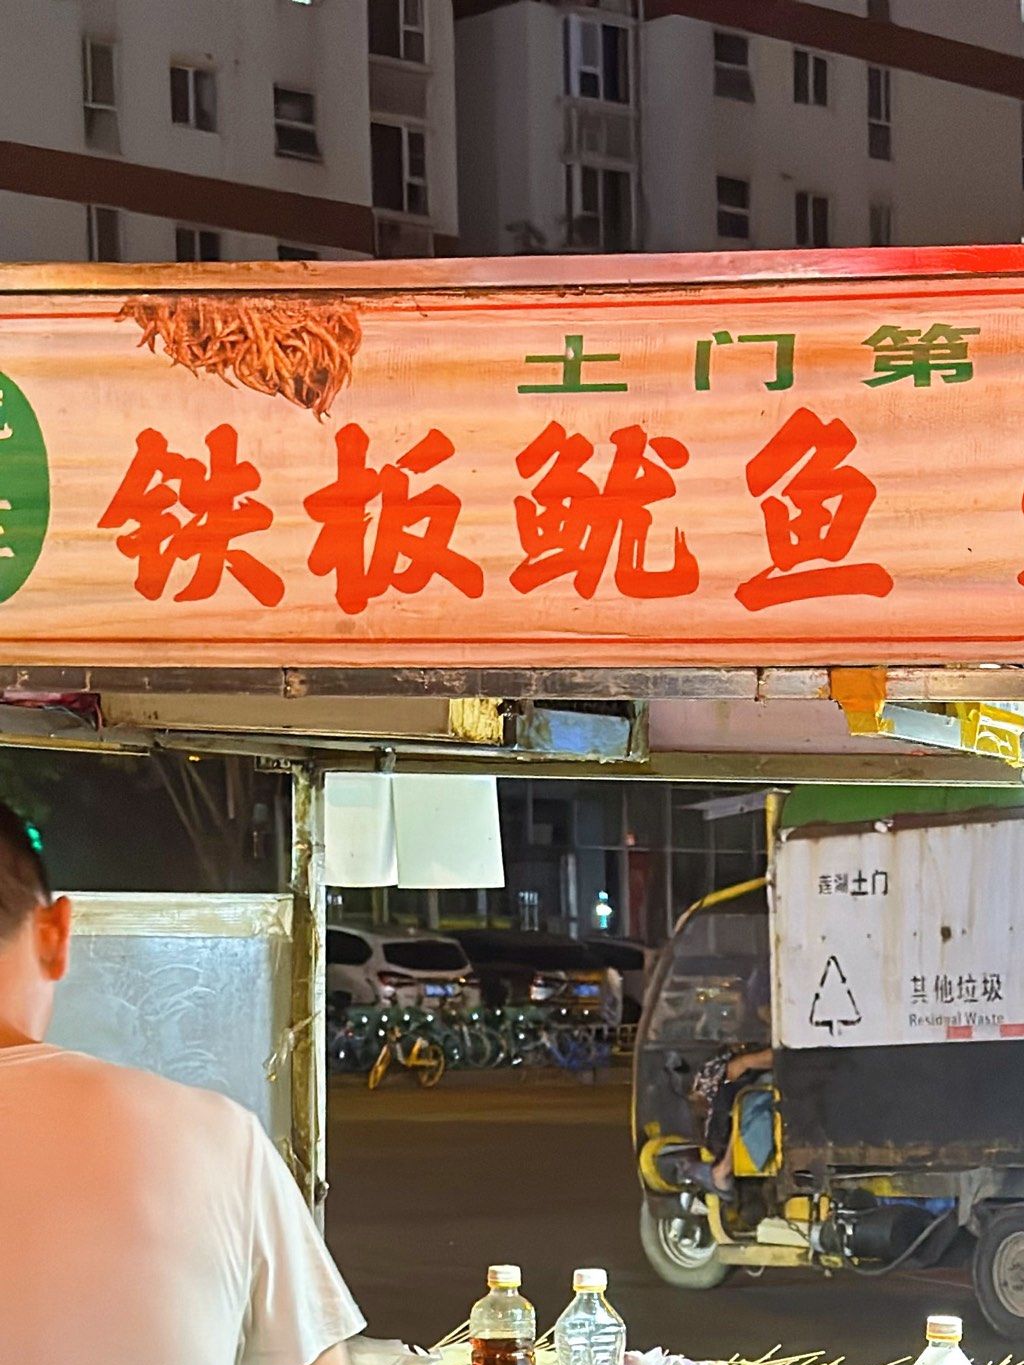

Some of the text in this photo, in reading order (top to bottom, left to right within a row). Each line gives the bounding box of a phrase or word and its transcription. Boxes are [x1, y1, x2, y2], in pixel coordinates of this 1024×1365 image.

[97, 400, 894, 615] 铁板鱿鱼
[909, 973, 1003, 1005] 其他垃圾
[965, 1010, 1005, 1026] Waste
